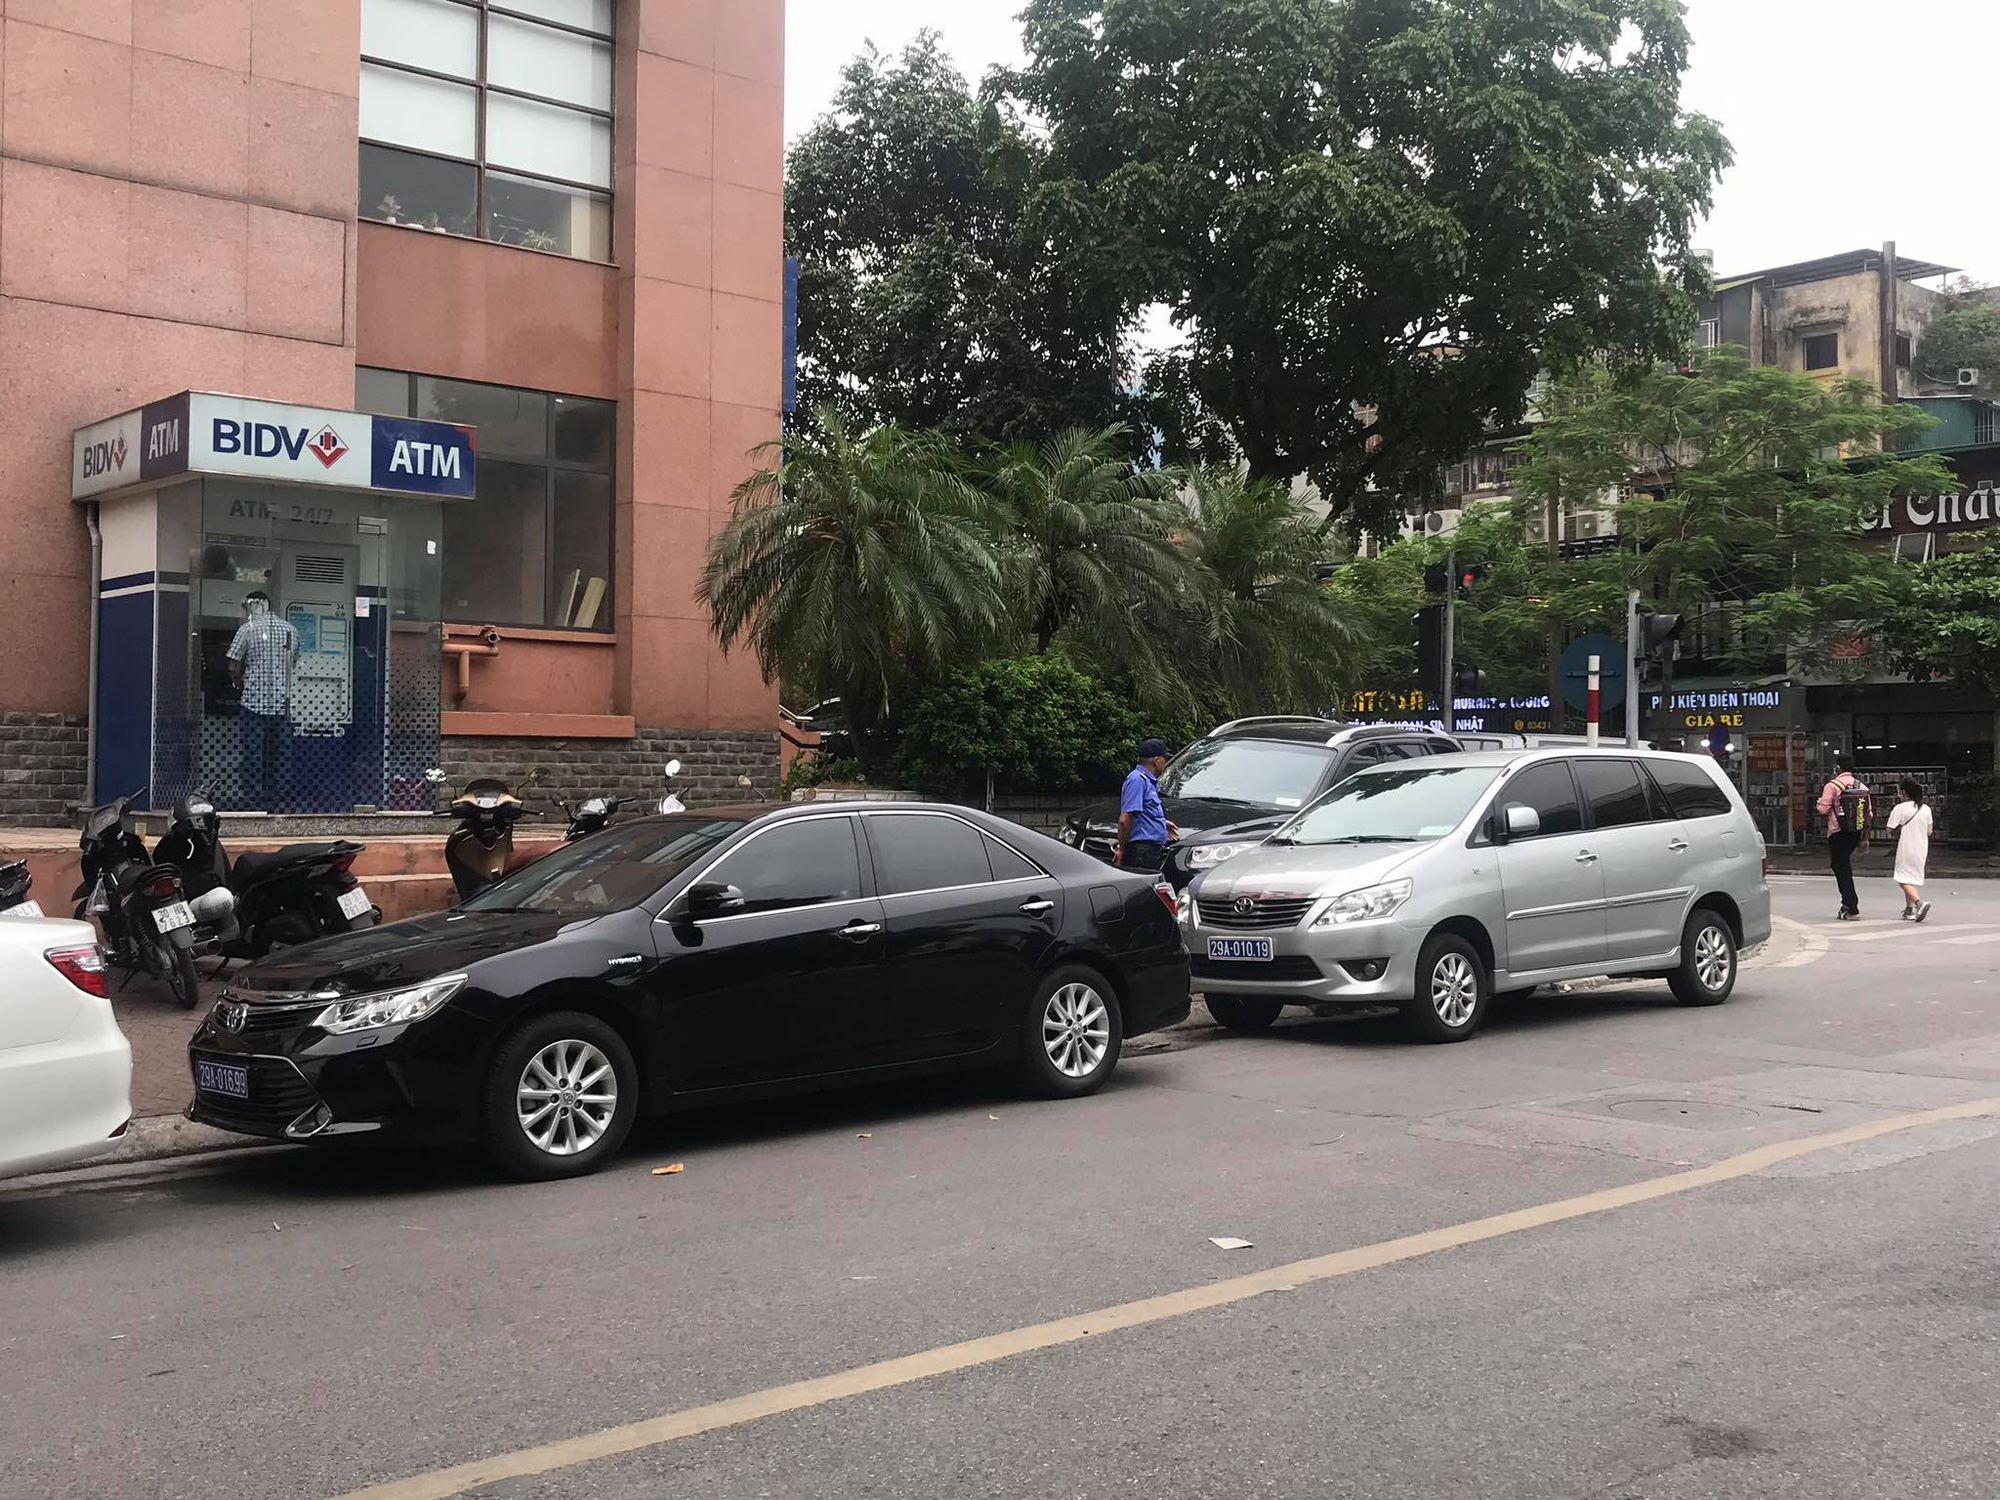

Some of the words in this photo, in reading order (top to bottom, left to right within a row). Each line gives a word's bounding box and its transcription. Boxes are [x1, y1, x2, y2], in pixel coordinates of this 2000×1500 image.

[82, 438, 116, 479] BIDV
[148, 417, 180, 461] ATM
[212, 417, 310, 461] BIDV
[388, 439, 461, 480] ATM
[1677, 691, 1706, 711] KIỆN
[1709, 690, 1739, 711] ĐIỆN
[1741, 691, 1779, 709] THOẠI
[1685, 711, 1716, 727] GIÁ
[1455, 715, 1485, 733] NHẬT
